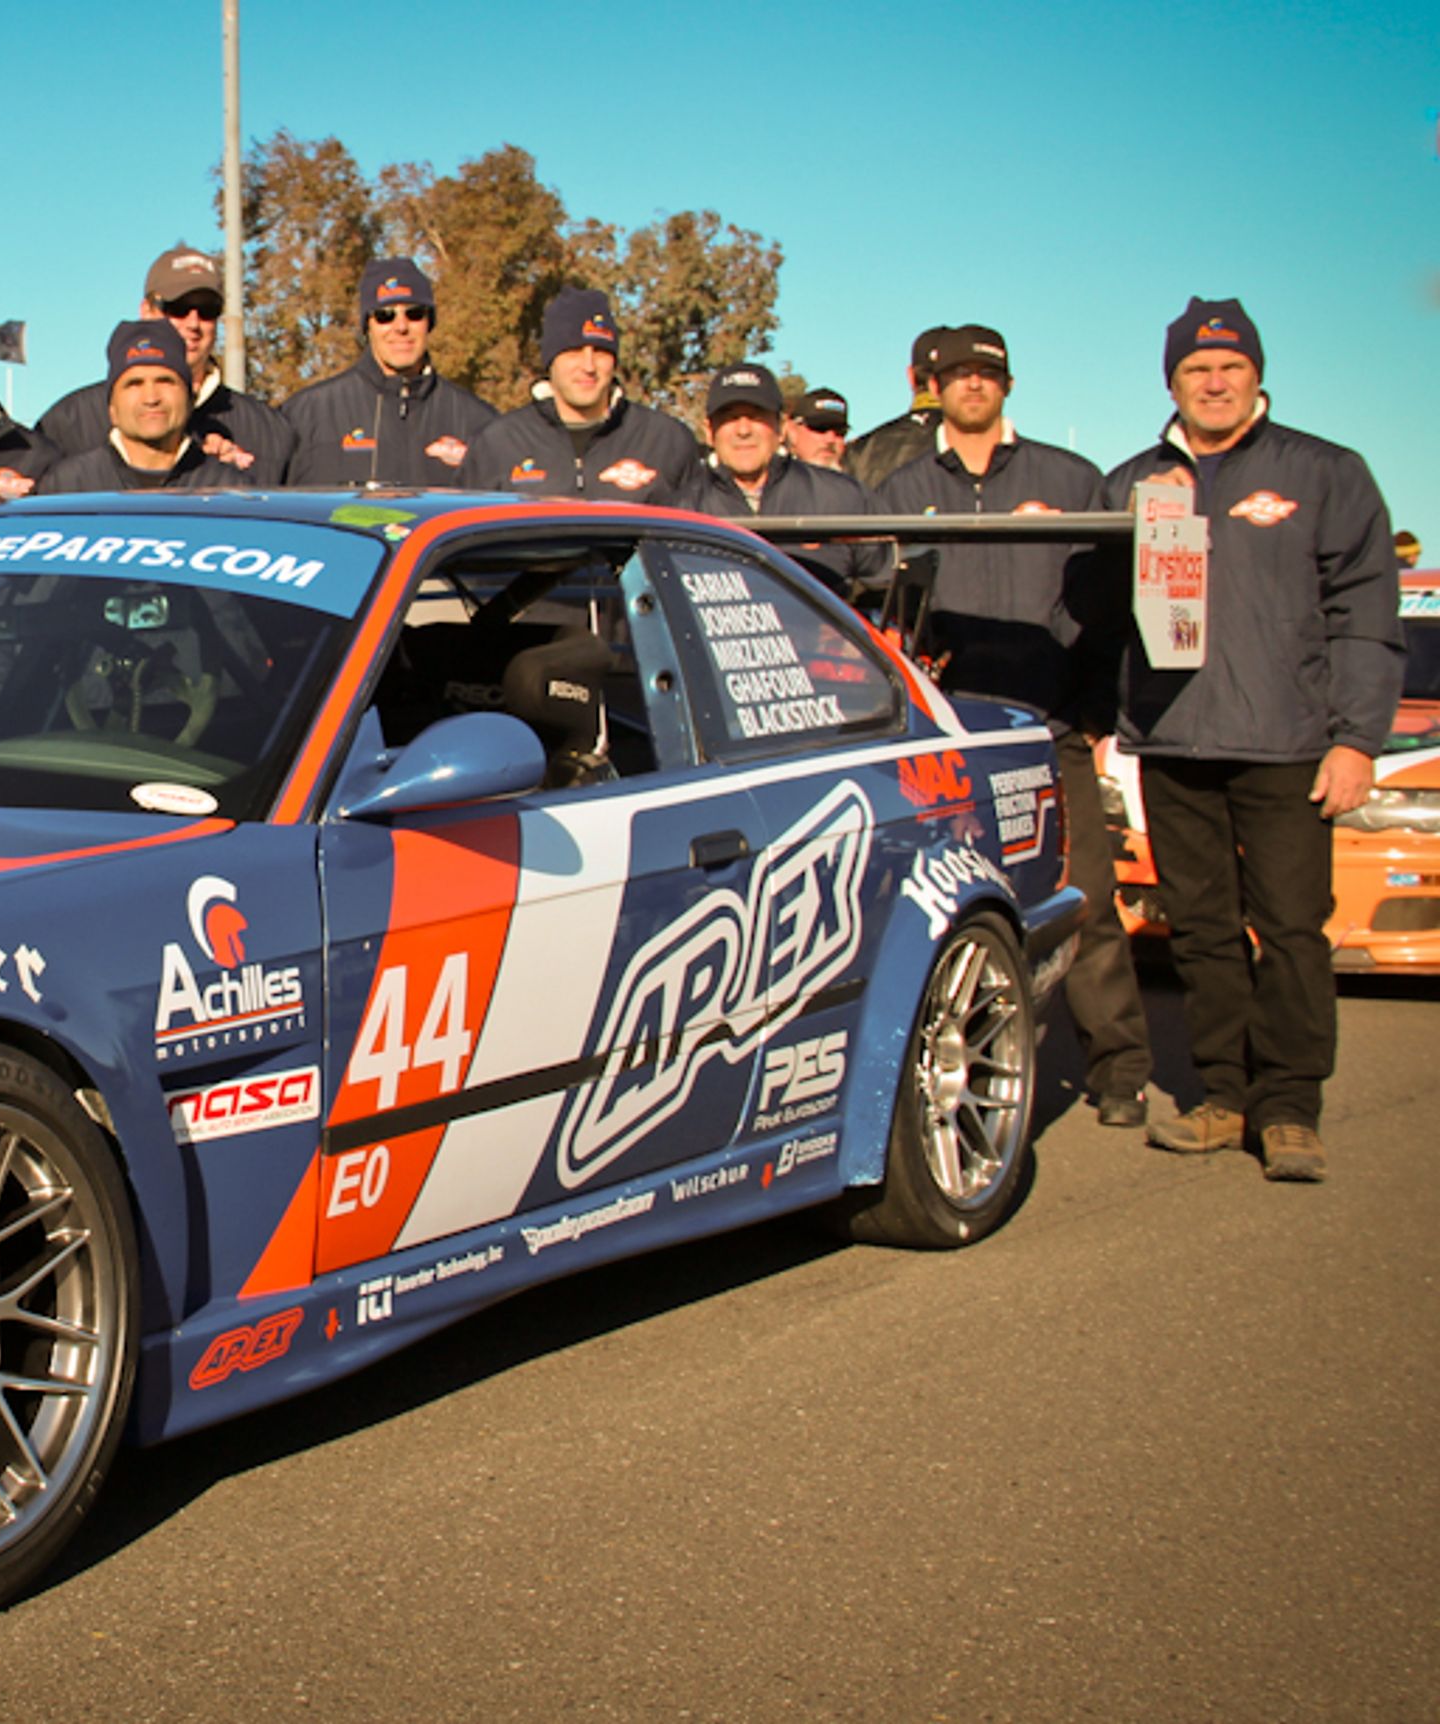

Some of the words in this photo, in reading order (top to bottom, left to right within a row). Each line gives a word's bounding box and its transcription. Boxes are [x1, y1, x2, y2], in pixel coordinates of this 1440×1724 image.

[681, 571, 752, 603] SARIAN
[698, 602, 783, 637] JOHNSON
[711, 635, 799, 671] MIRZAYAN
[725, 666, 815, 704] GHAFOURI
[736, 695, 847, 738] BLACKSTOCK
[156, 943, 302, 1031] Achilles
[157, 1014, 306, 1061] motorsport
[348, 952, 471, 1110] 44
[758, 1029, 848, 1111] PES
